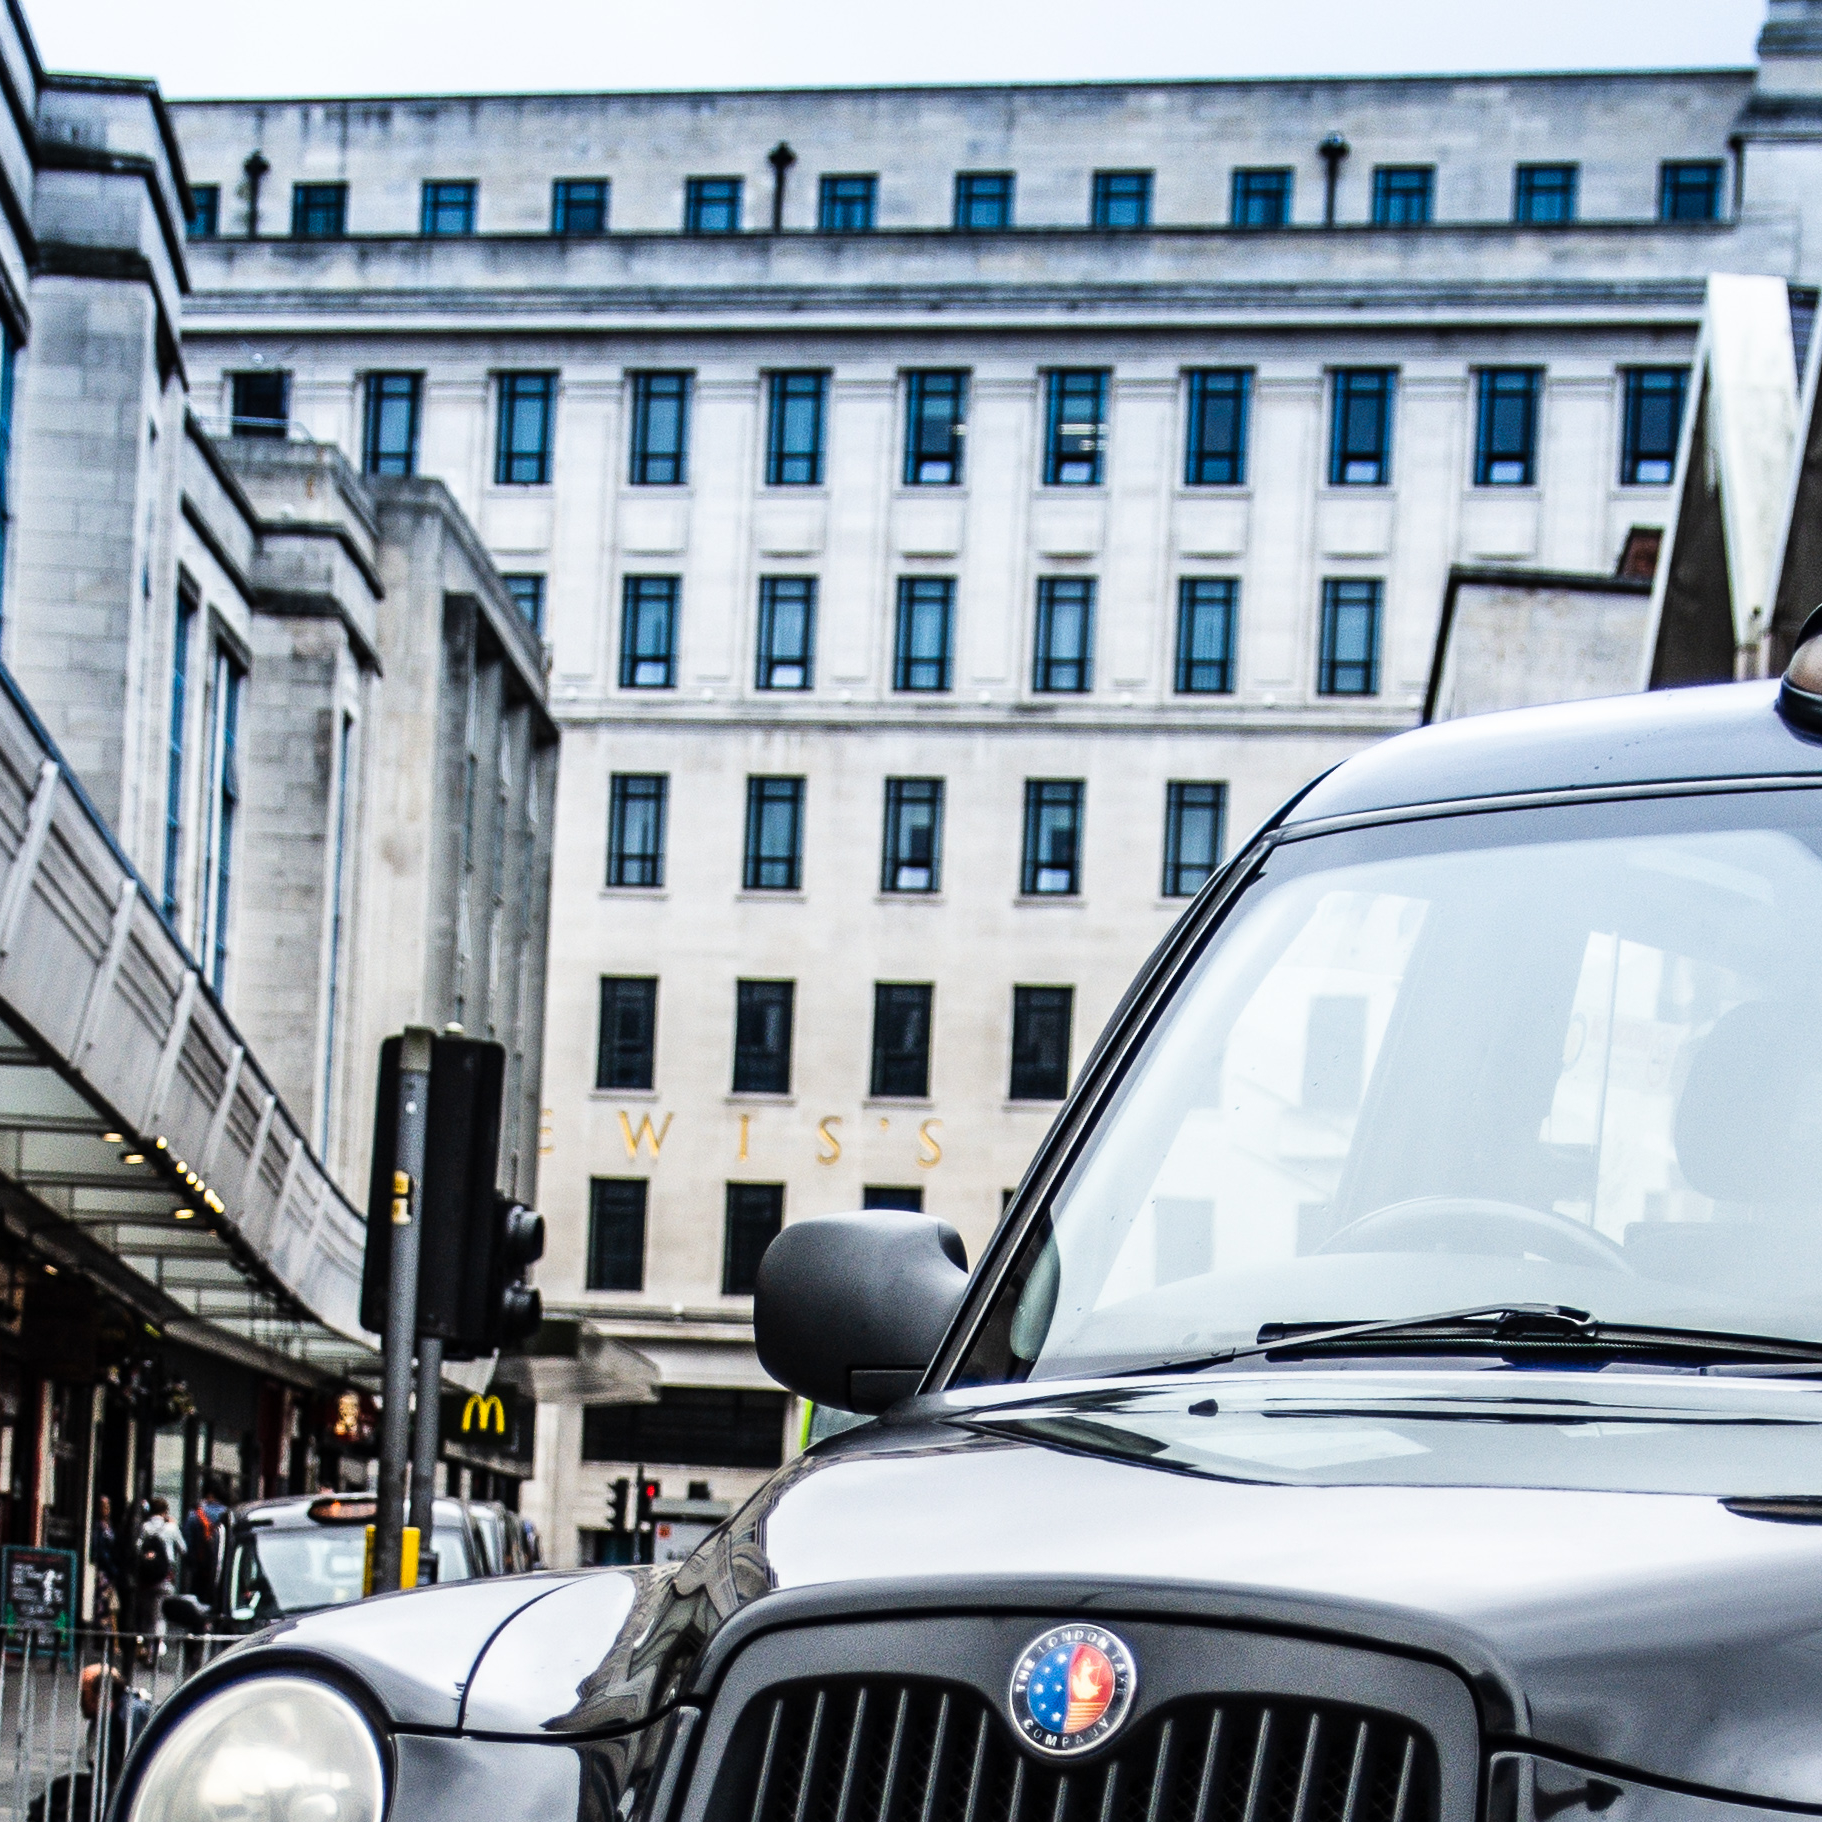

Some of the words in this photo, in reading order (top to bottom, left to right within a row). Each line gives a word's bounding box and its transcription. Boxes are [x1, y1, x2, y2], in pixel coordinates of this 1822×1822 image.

[1015, 1658, 1036, 1693] THE
[1038, 1630, 1109, 1653] LONDON
[1110, 1650, 1129, 1695] TAXI
[1022, 1717, 1109, 1748] COMPANY
